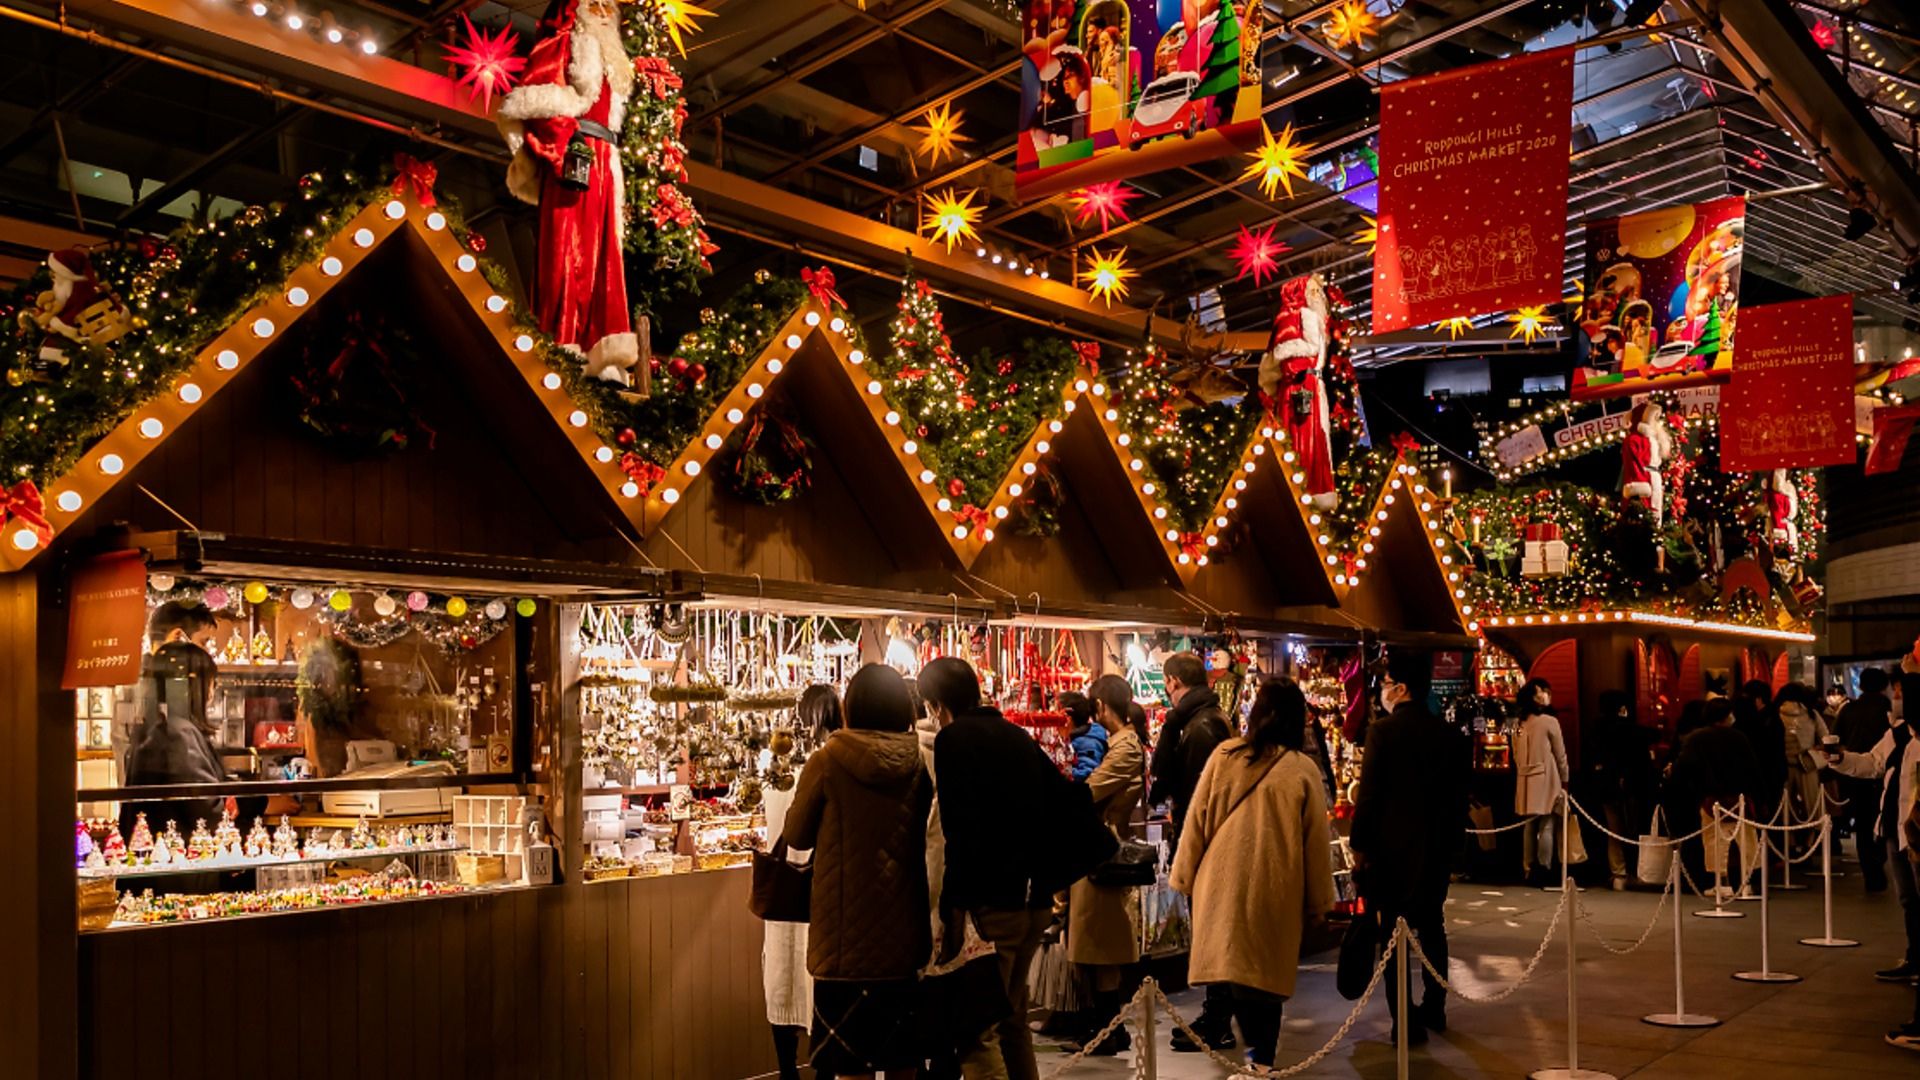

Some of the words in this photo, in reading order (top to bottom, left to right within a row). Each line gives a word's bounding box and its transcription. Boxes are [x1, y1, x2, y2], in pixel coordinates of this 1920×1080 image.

[1393, 152, 1464, 178] CHRISTMAS
[1467, 140, 1523, 163] MARKET
[1525, 134, 1557, 151] 2020
[1424, 130, 1482, 154] ROPPONGI
[1486, 123, 1523, 141] HILLS
